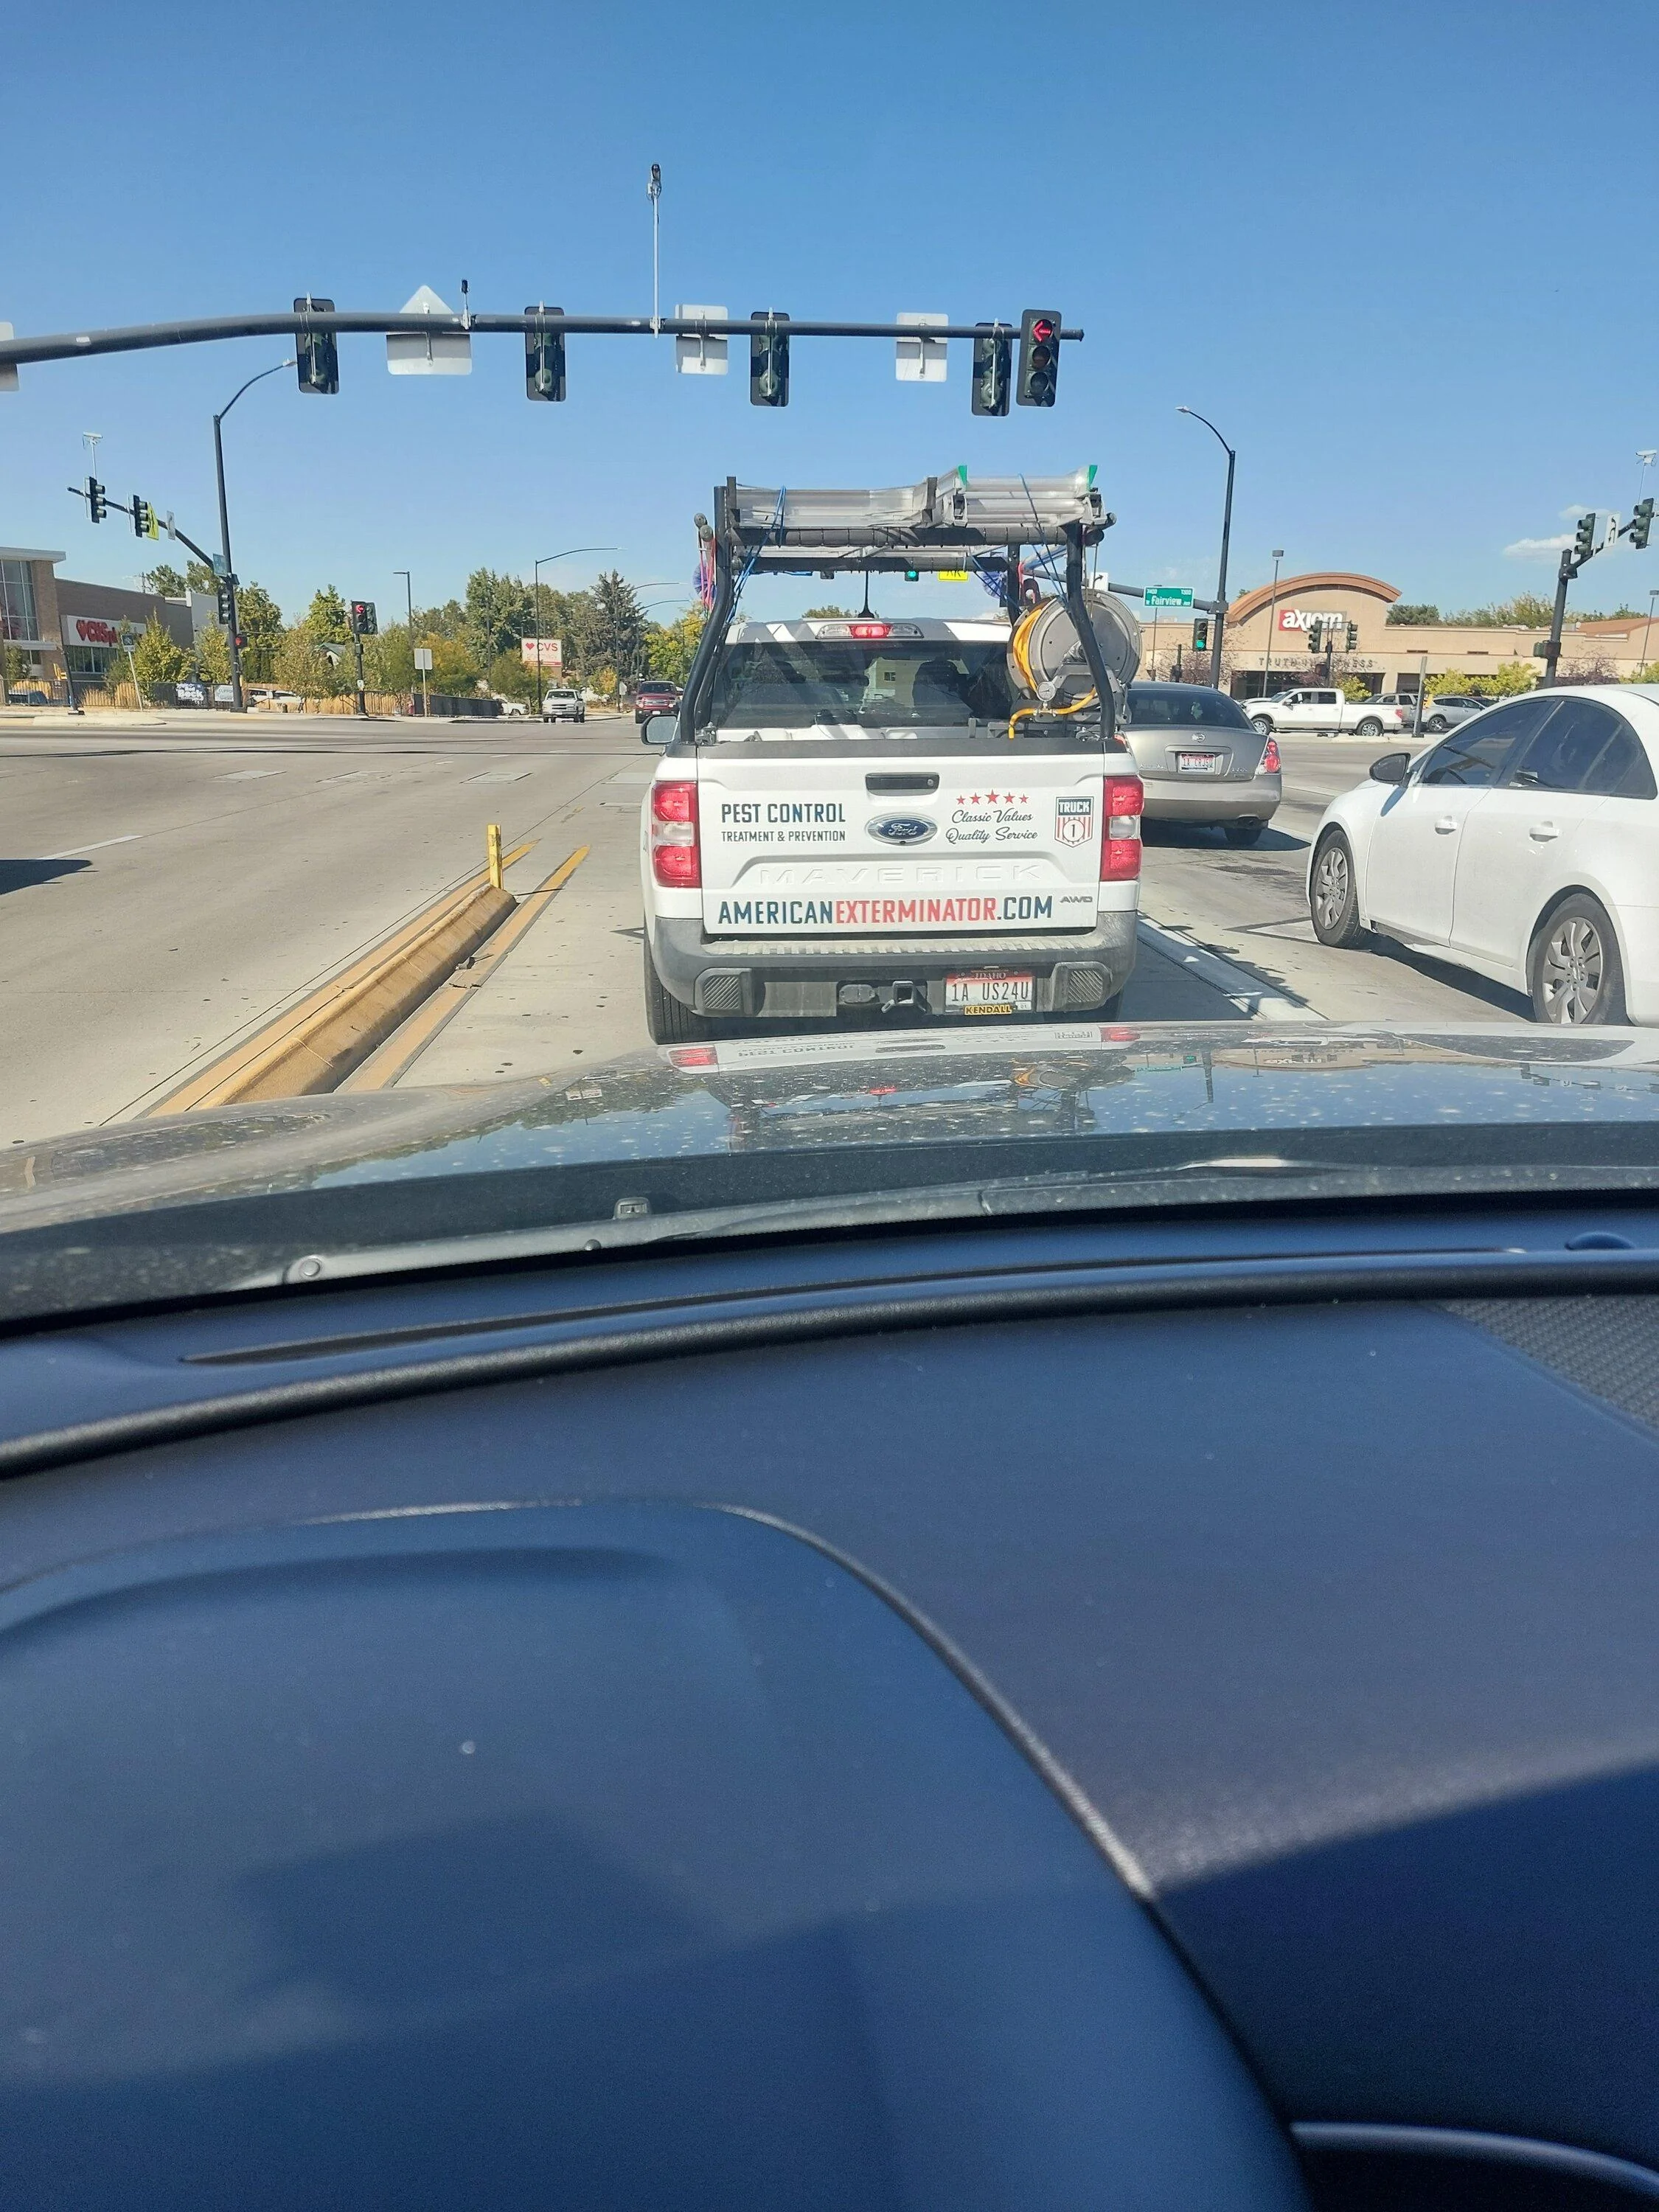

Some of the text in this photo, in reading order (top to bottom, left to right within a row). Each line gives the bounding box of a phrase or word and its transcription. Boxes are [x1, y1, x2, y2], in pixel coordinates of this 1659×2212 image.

[1151, 595, 1182, 605] Fairview
[537, 642, 558, 652] CVS
[721, 803, 846, 823] PEST CONTROL
[1058, 801, 1091, 814] TRUCK
[951, 808, 1034, 824] Classic Values
[888, 823, 918, 835] Ford
[721, 830, 846, 842] TREATMENT & PREVENTION
[945, 827, 1038, 844] Quality Service
[760, 865, 1043, 885] MAVERICK
[1060, 895, 1093, 903] AWD
[717, 895, 1053, 924] AMERICANEXTERMINATOR.COM
[975, 972, 1006, 980] IDAHO
[952, 982, 1029, 1001] 1A US24U
[965, 1005, 1012, 1014] KENDALL
